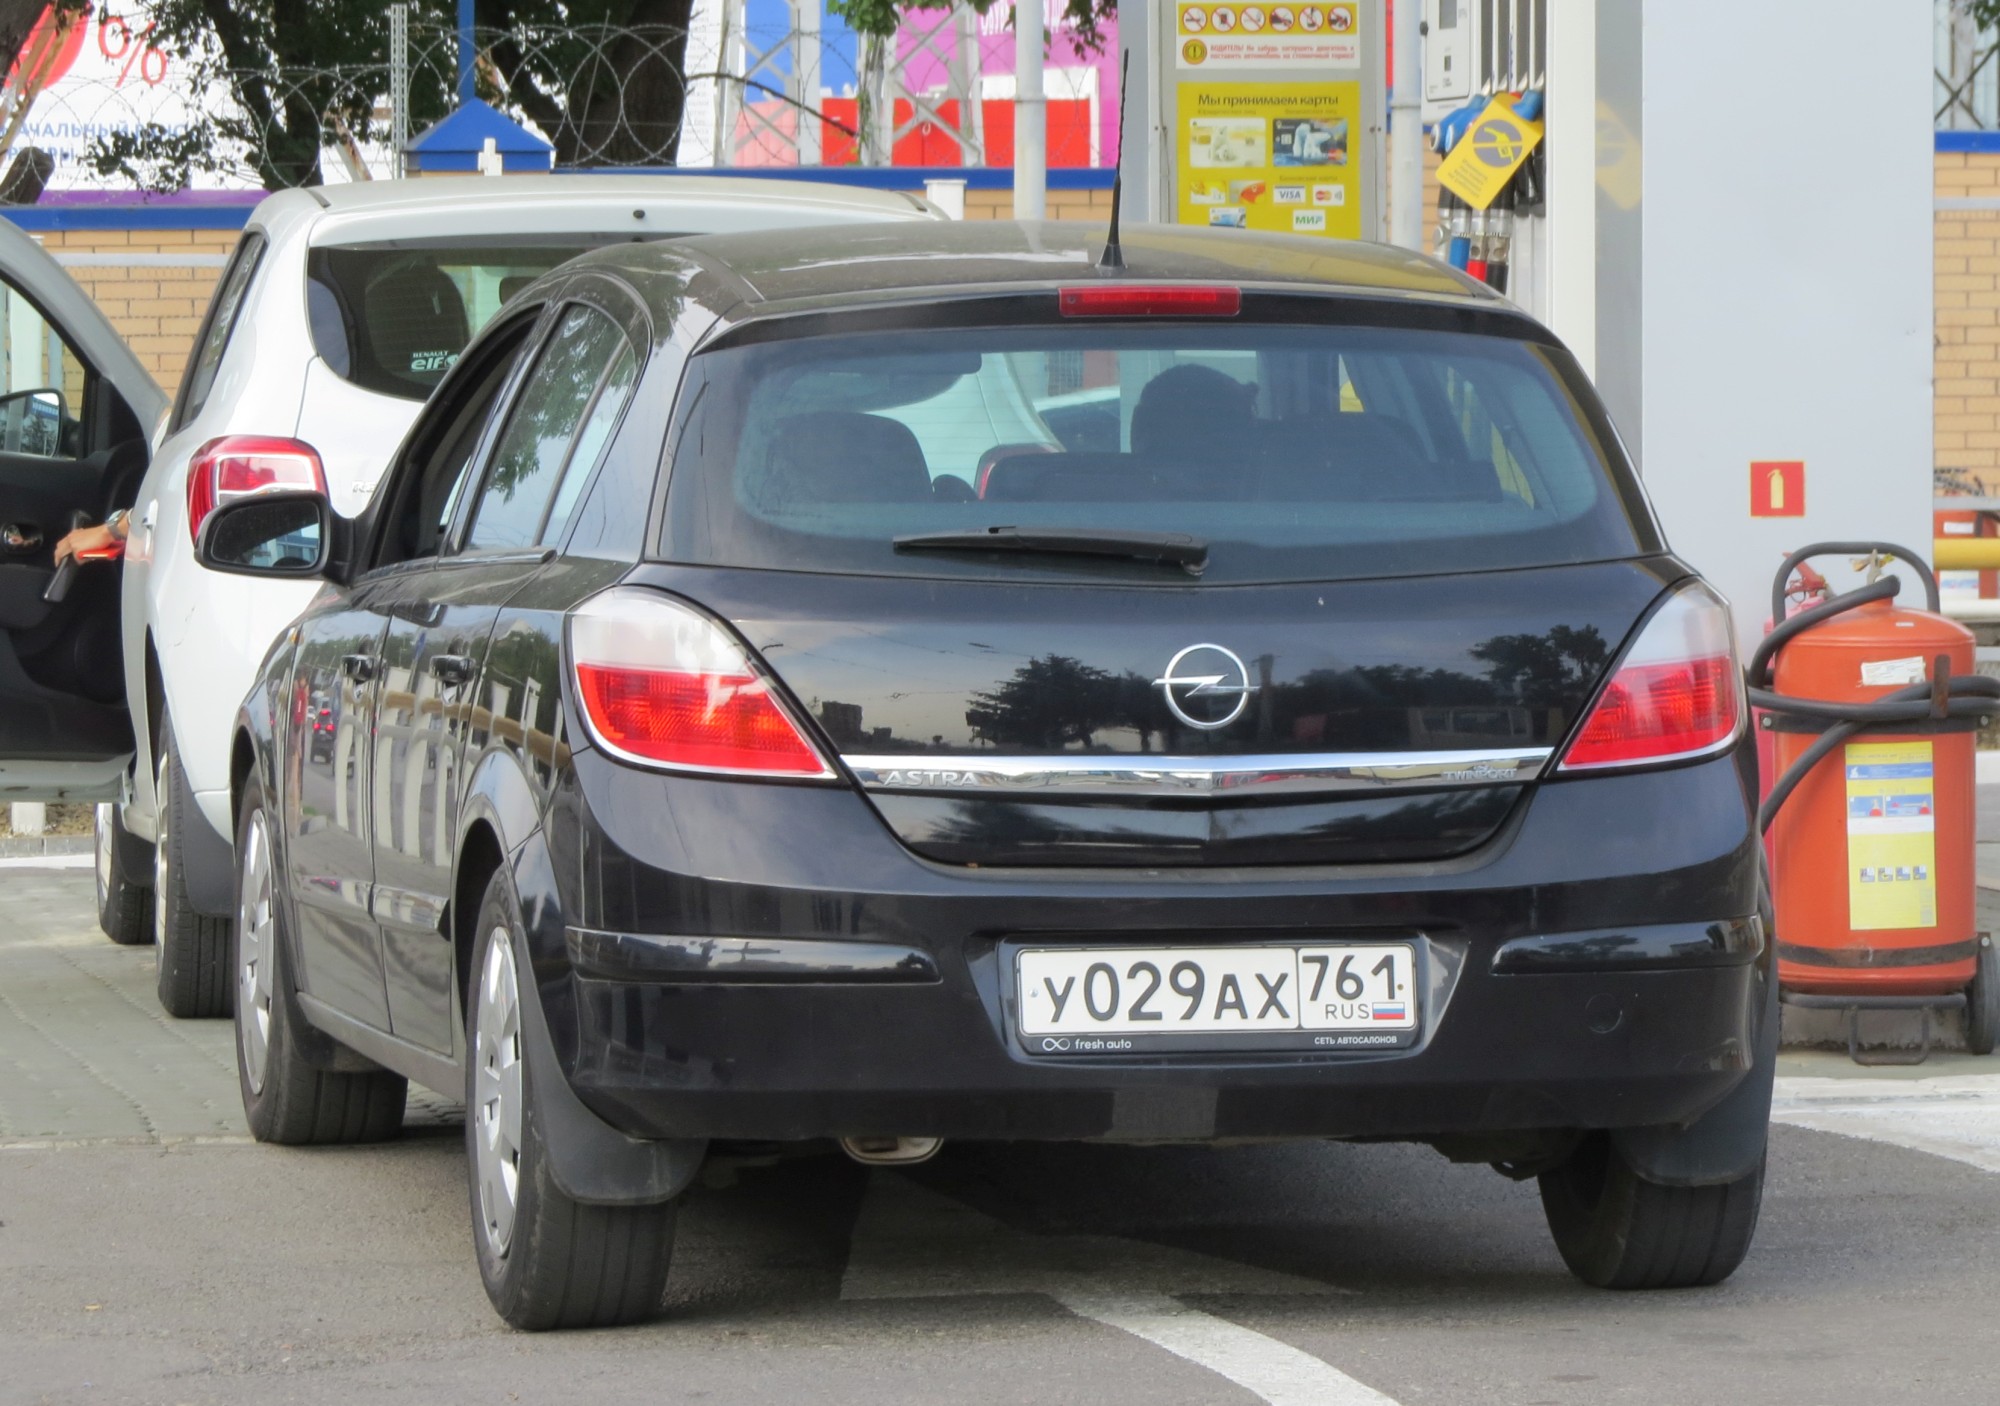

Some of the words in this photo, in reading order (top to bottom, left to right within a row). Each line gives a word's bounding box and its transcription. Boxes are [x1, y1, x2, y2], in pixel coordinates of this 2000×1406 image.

[1198, 94, 1221, 105] Мы
[1223, 96, 1298, 107] принимаем
[1300, 96, 1339, 107] карты
[1280, 190, 1302, 199] VISA
[1295, 215, 1323, 225] МИР
[413, 350, 449, 358] RENAULT
[411, 357, 445, 370] elf
[884, 770, 981, 786] ASTRA
[1443, 767, 1518, 780] TWINPORT
[1302, 954, 1398, 1001] 761
[1325, 1003, 1370, 1020] RUS
[1075, 1038, 1105, 1049] fresh
[1106, 1038, 1132, 1049] auto
[1314, 1036, 1336, 1045] СЕТЬ
[1336, 1035, 1398, 1045] АВТОСАЛОНОВ
